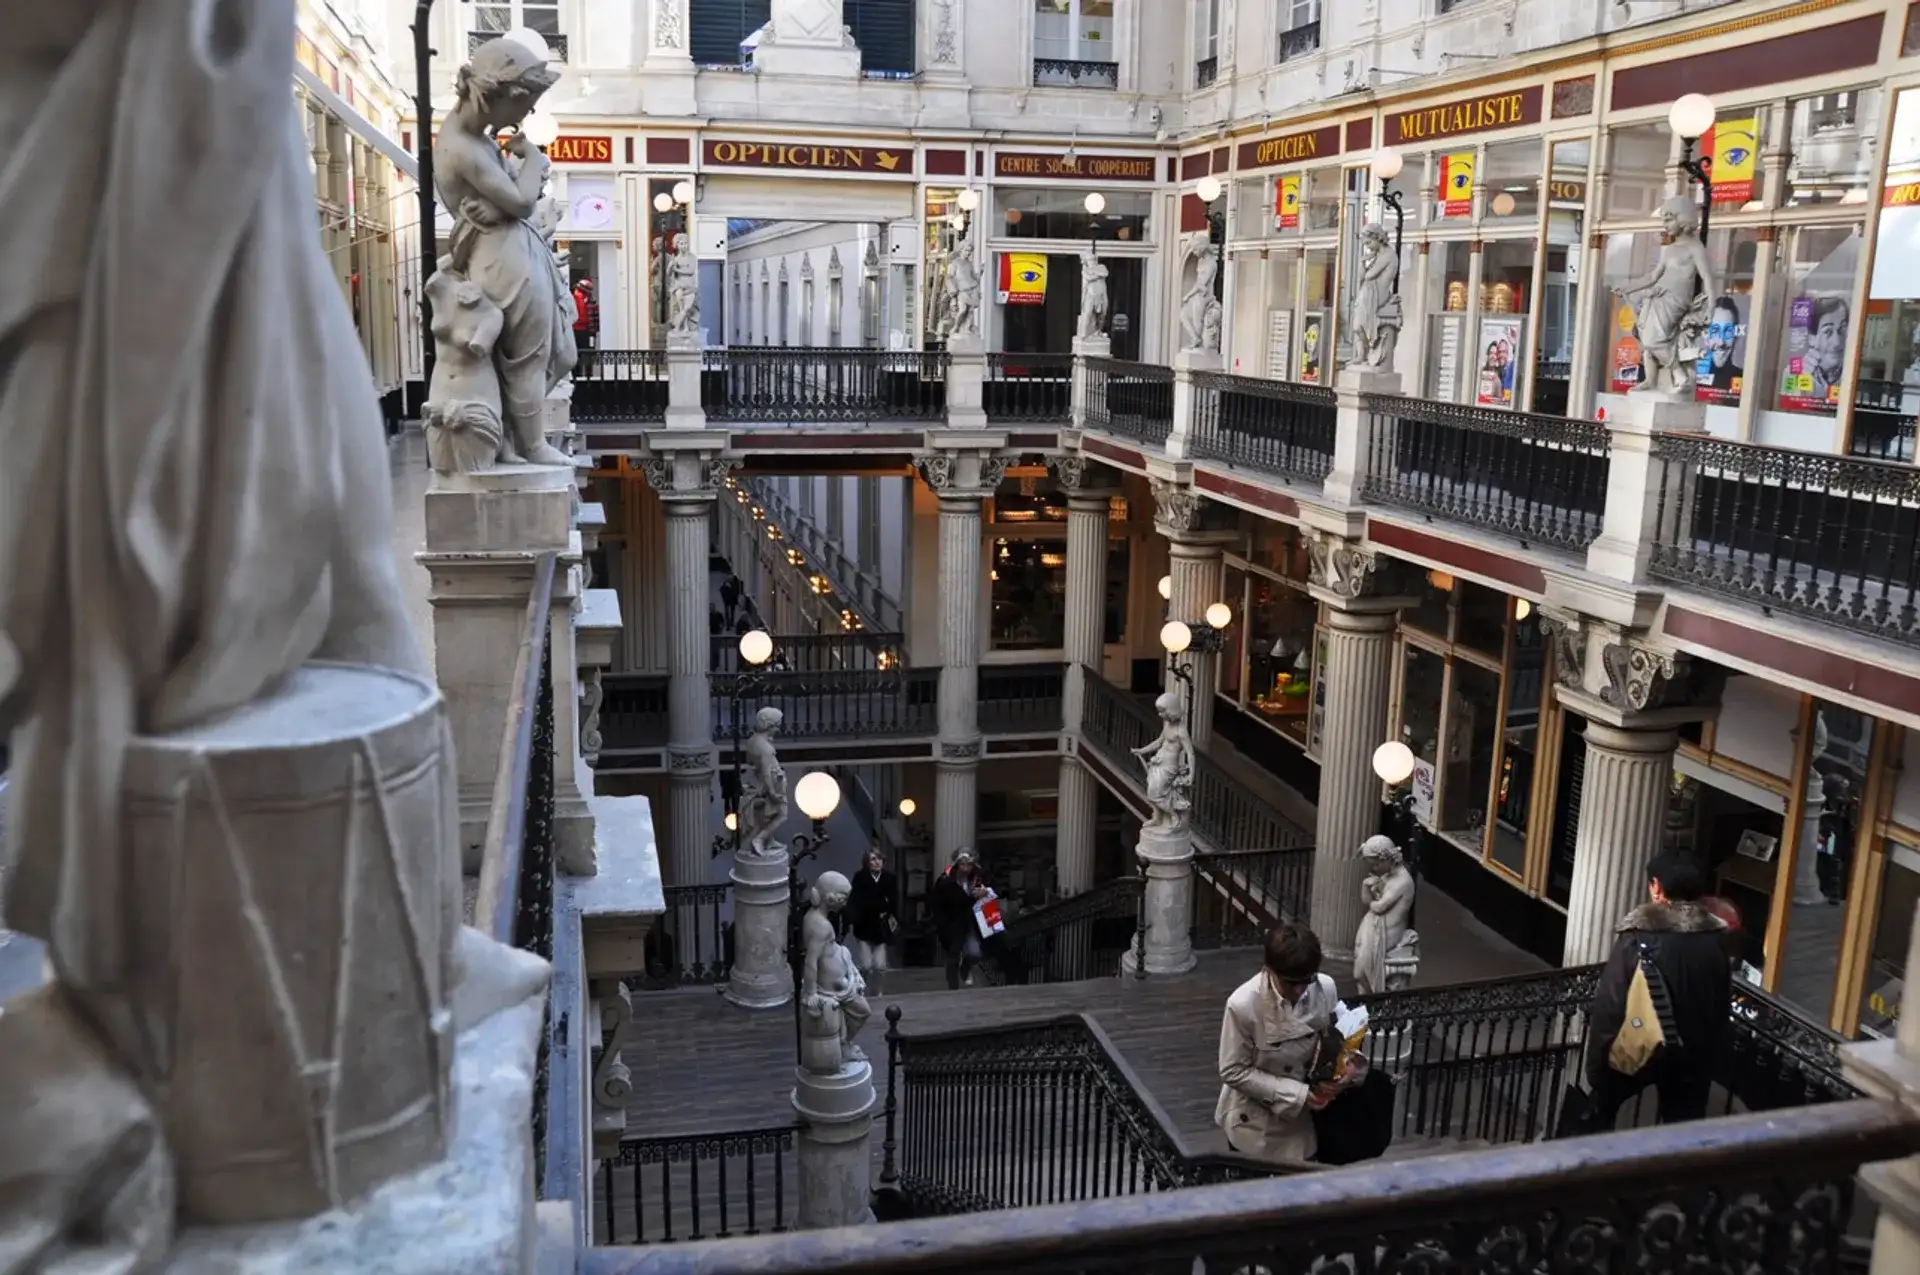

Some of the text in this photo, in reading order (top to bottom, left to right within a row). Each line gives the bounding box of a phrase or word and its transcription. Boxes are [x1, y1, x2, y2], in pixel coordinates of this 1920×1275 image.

[1399, 94, 1523, 140] MUTUALISTE
[547, 139, 608, 160] HAUTS
[713, 142, 864, 168] OPTICIEN
[1257, 133, 1317, 164] OPTICIEN
[1000, 156, 1041, 174] CENTRE
